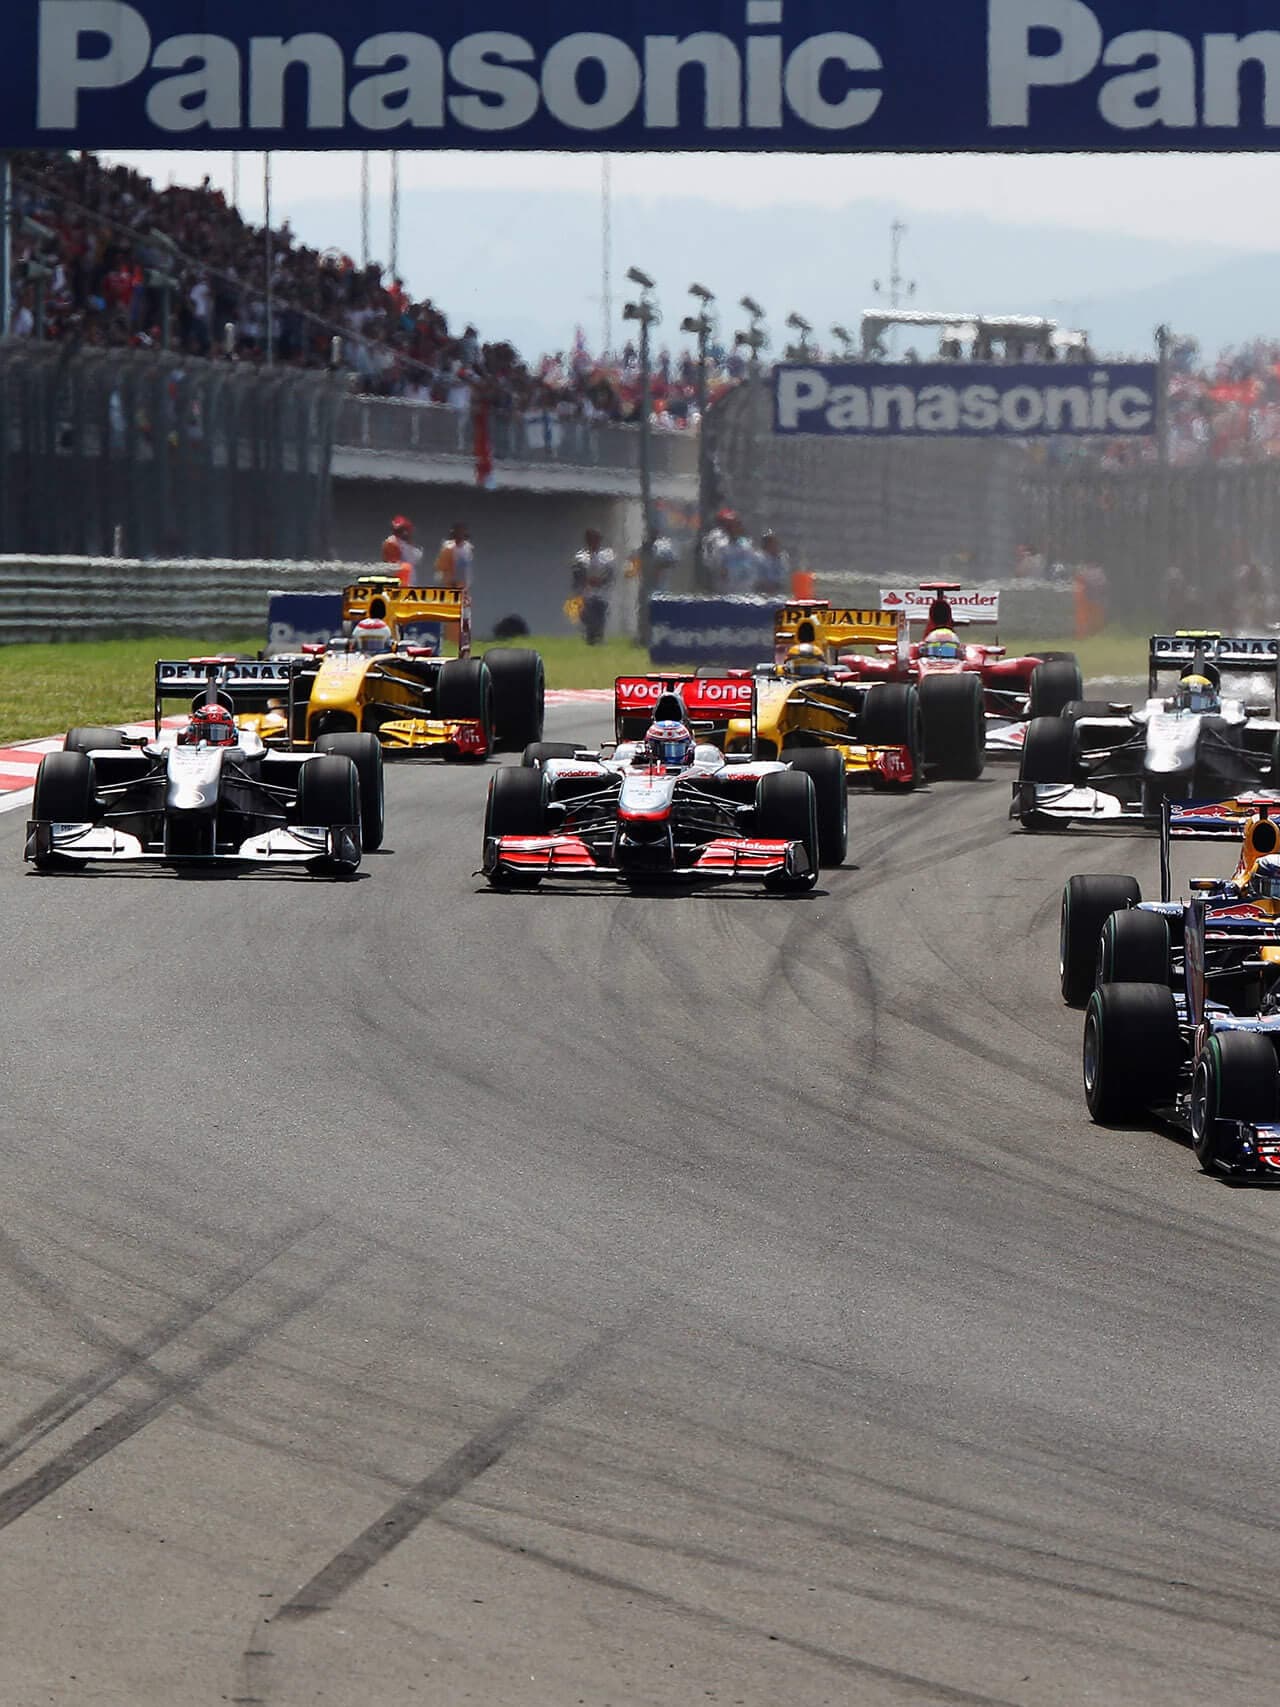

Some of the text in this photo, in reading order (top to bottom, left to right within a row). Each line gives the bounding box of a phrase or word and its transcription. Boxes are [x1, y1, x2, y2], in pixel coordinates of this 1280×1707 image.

[36, 0, 884, 132] Panasonic
[775, 369, 1153, 431] Panasonic
[905, 592, 997, 606] Sanander
